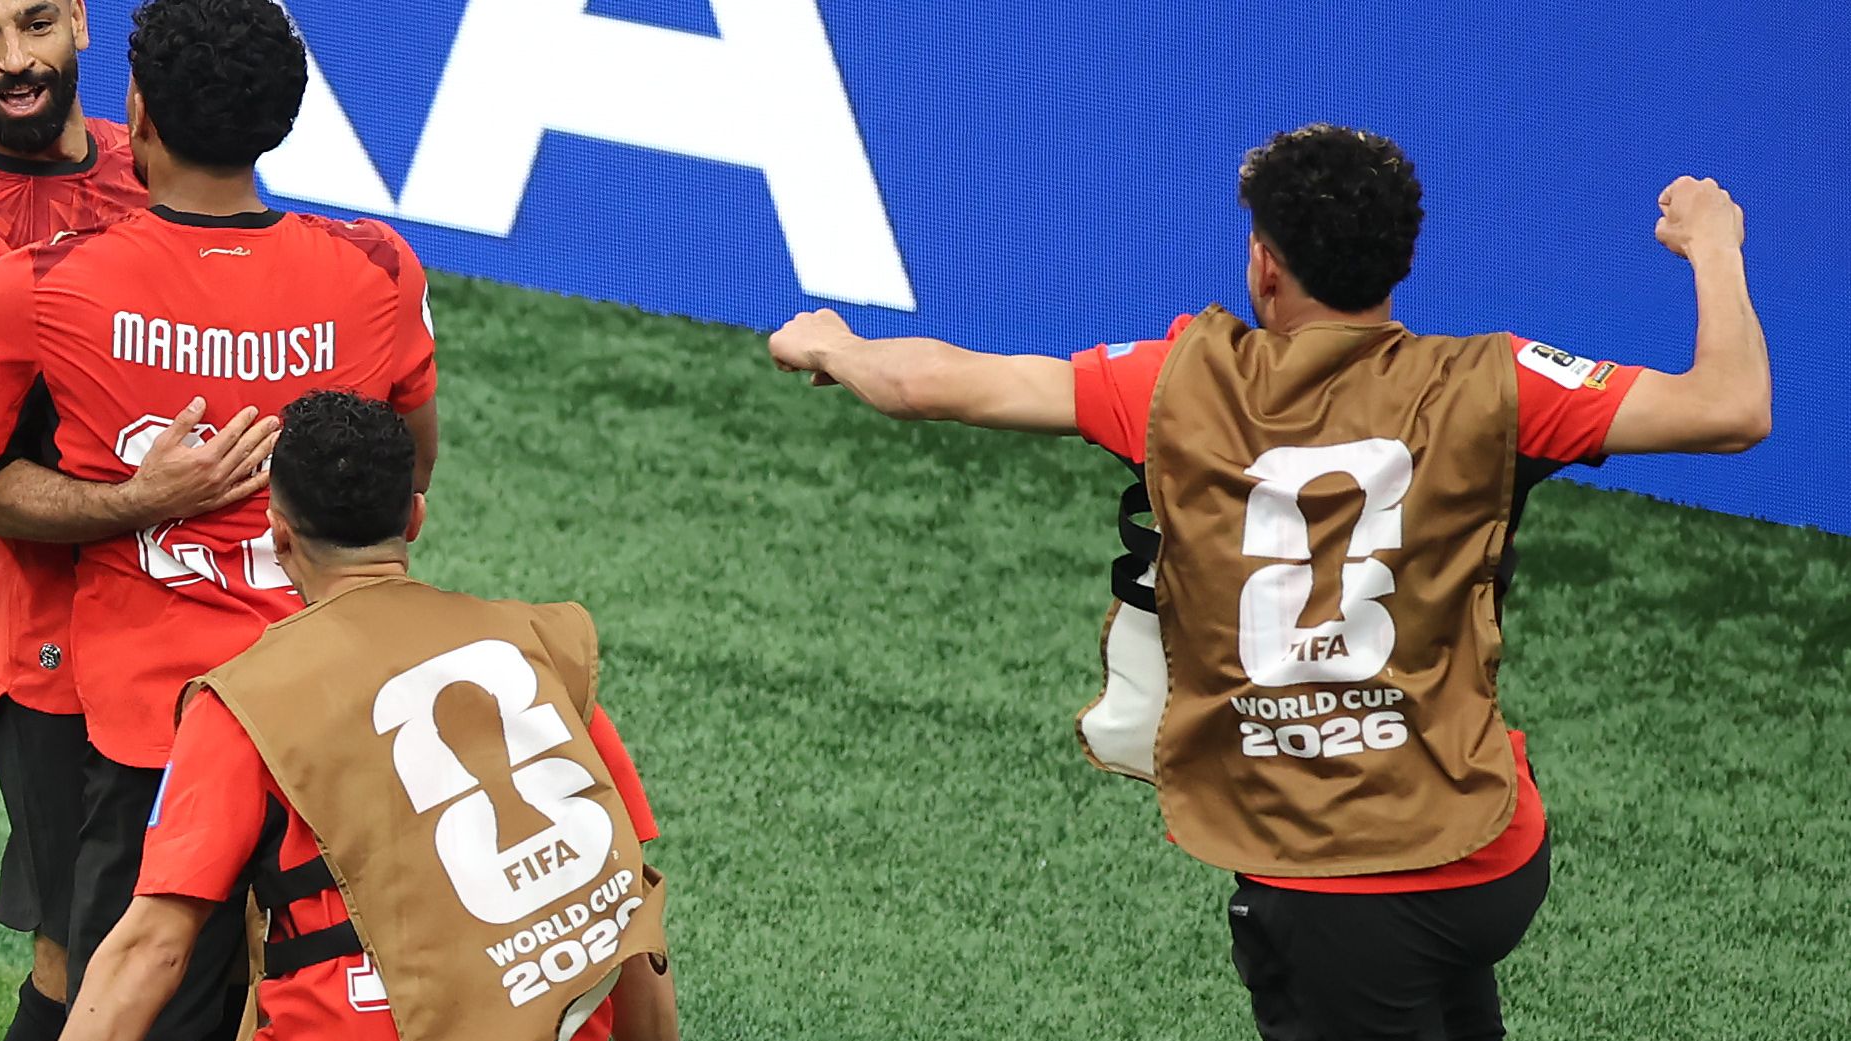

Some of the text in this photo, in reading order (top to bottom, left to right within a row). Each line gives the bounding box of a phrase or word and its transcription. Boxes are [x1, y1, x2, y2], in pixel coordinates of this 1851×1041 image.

[112, 310, 335, 382] MARMOUSH
[1231, 688, 1405, 721] WORLD CUP
[1239, 710, 1408, 759] 2026
[502, 839, 580, 892] FIFA
[486, 869, 634, 967] WORLD CUP
